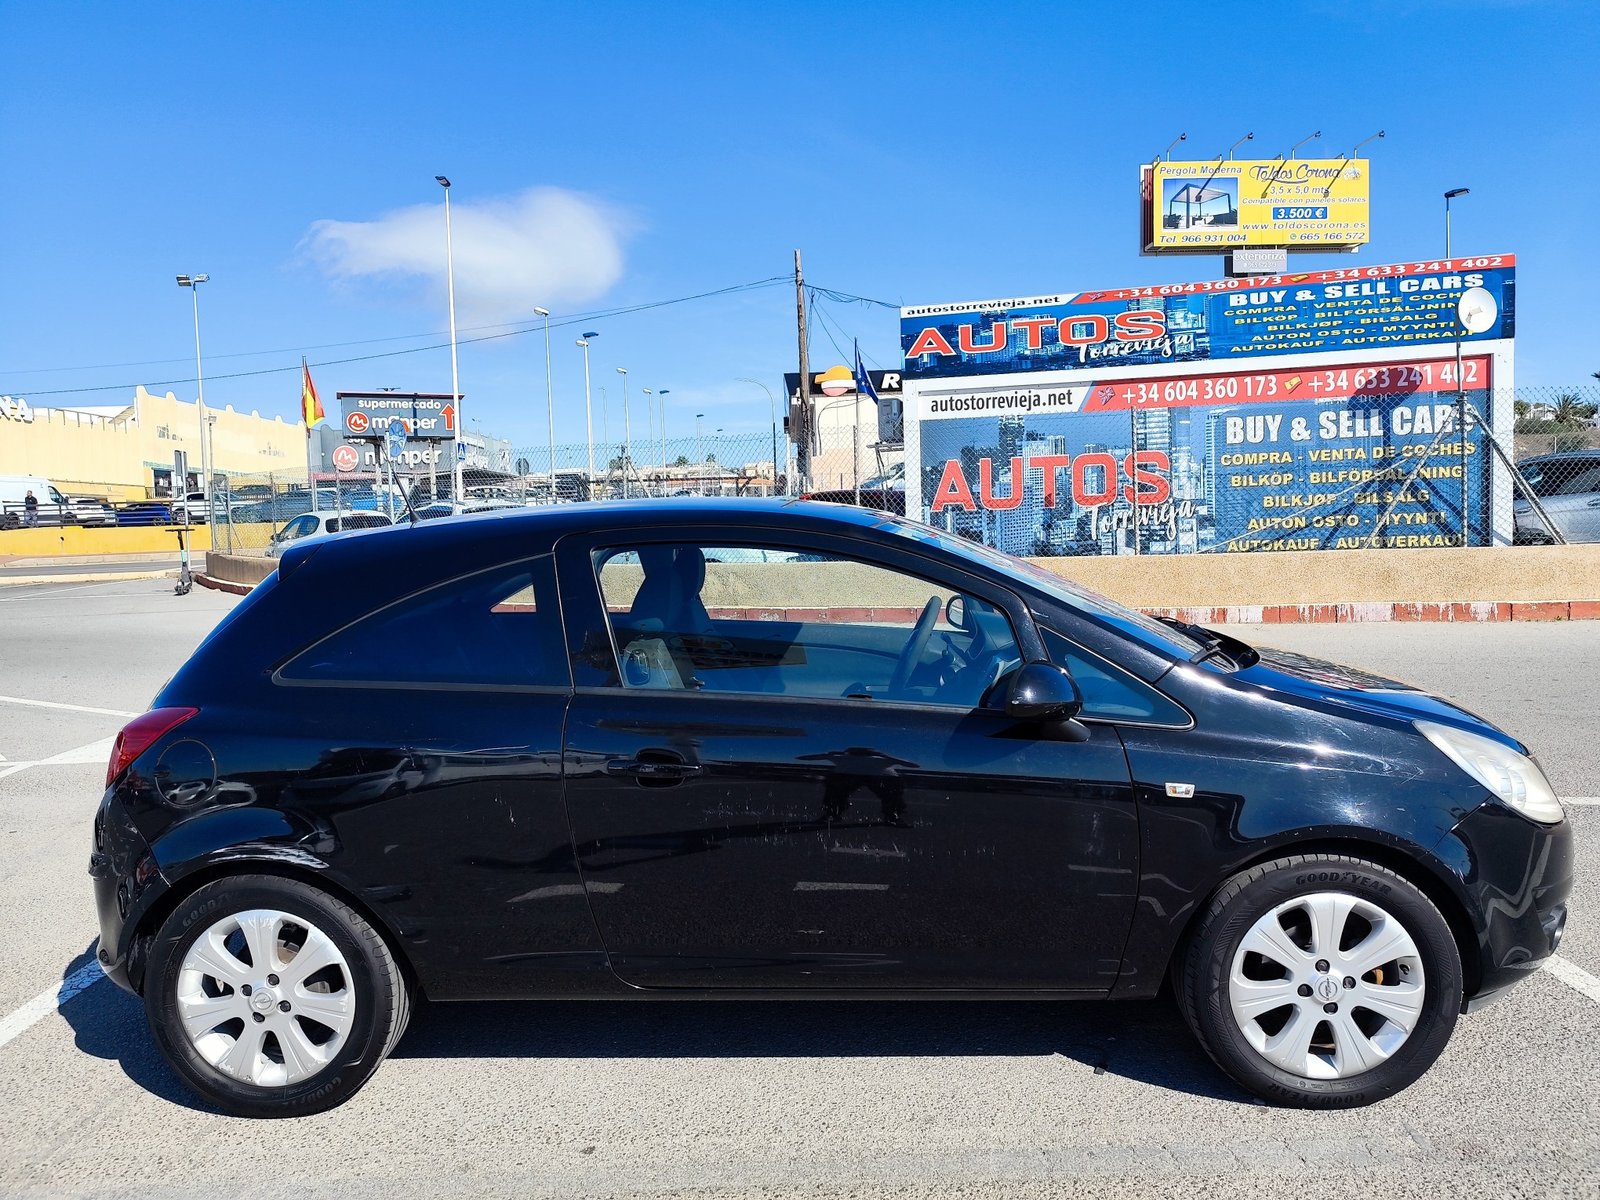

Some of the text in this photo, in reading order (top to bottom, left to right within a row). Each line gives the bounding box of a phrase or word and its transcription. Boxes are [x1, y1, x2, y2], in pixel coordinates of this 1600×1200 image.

[1159, 166, 1242, 176] Pergola Moderna
[1249, 163, 1341, 182] Toldos Corona
[1270, 186, 1284, 195] 3,5
[1295, 186, 1310, 195] 5,0
[1242, 197, 1287, 205] Compatible
[1277, 208, 1325, 218] 3.500 €
[1242, 222, 1366, 230] www.toldoscorona.es
[1181, 235, 1202, 243] 966
[1204, 234, 1224, 242] 931
[1226, 234, 1247, 242] 004
[1324, 232, 1342, 240] 166
[1345, 232, 1366, 240] 572
[1234, 252, 1286, 261] exterioriza
[907, 257, 1503, 315] autostorrevieja.net +34 604 360 173 +34 633 241 402
[1229, 273, 1484, 307] BUY & SELL CARS
[1223, 305, 1296, 317] COMPRA
[1313, 298, 1371, 310] VENTA
[1379, 295, 1403, 305] DE
[1409, 291, 1463, 302] COCH
[1234, 313, 1297, 325] BILKÖP
[1314, 301, 1456, 319] BILFÖRSÄLJNIN
[1267, 319, 1343, 331] BILKJØP
[1360, 313, 1438, 325] BILSALG
[905, 310, 1167, 359] AUTOS
[1251, 331, 1311, 342] AUTON
[1317, 327, 1366, 337] OSTO
[1383, 321, 1455, 332] MYYNTI
[1074, 334, 1192, 363] Torrevieja
[1230, 340, 1325, 353] AUTOKAUF
[930, 361, 1478, 412] autostorrevieja.net +34 604 360 173 +34 633 241 402
[358, 399, 441, 410] supermercado
[371, 415, 438, 433] mper
[1226, 414, 1283, 444] BUY
[1290, 416, 1312, 441] &
[1318, 408, 1384, 439] SELL
[365, 450, 442, 469] mnper
[1221, 451, 1293, 466] COMPRA
[1308, 447, 1367, 462] VENTA
[1372, 446, 1396, 459] DE
[1401, 442, 1476, 457] COCHES
[931, 450, 1171, 512] AUTOS
[1231, 471, 1294, 487] BILKÖP
[1310, 466, 1463, 484] BILFÖRSÄLNING
[1263, 493, 1337, 508] BILKJØP
[1354, 490, 1430, 504] BILSALG
[1247, 516, 1306, 530] AUTON
[1312, 514, 1359, 528] OSTO
[1227, 538, 1319, 552] AUTOKAUF
[1295, 871, 1393, 896] GOODYEAR
